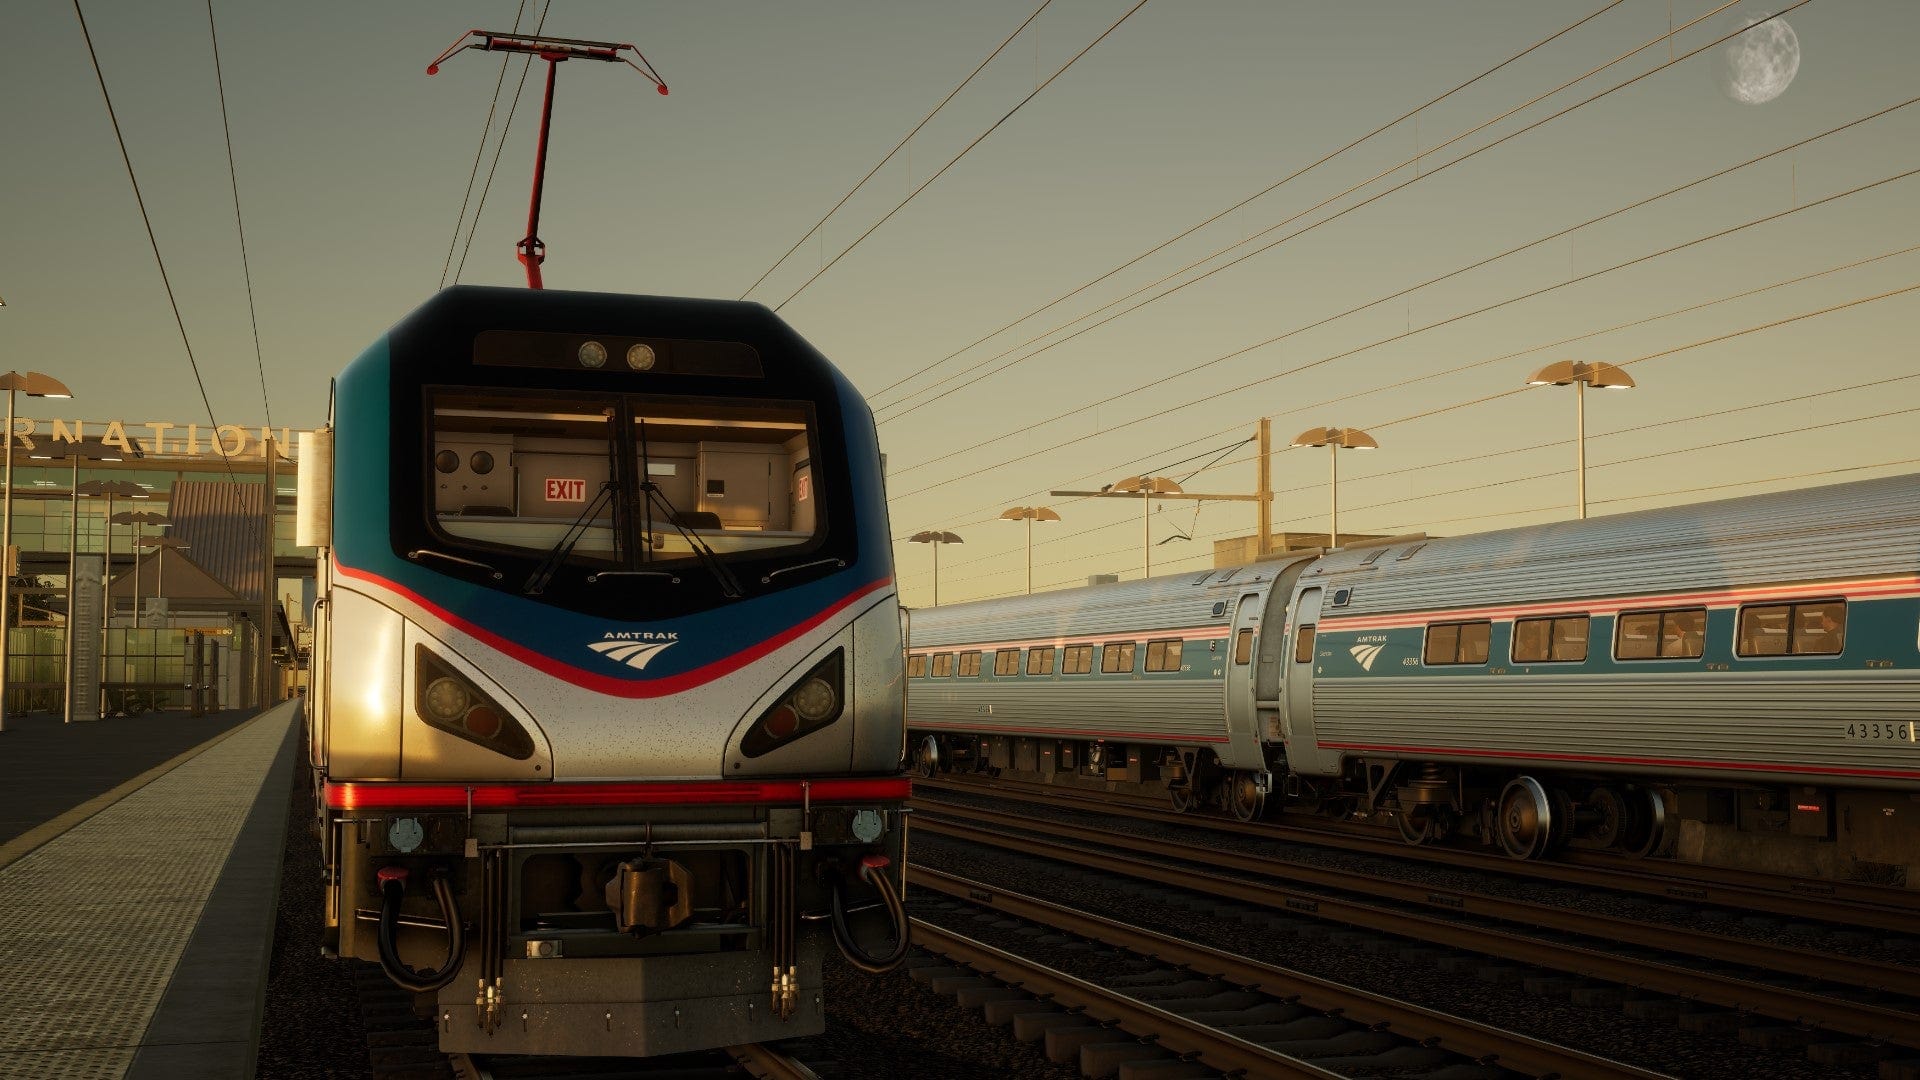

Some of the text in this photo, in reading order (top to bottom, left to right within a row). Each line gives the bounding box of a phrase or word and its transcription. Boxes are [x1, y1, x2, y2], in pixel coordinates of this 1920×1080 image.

[547, 480, 584, 500] EXIT
[603, 632, 678, 640] AMTRAK
[1357, 635, 1387, 643] AMTRAK
[1847, 723, 1907, 740] 43356
